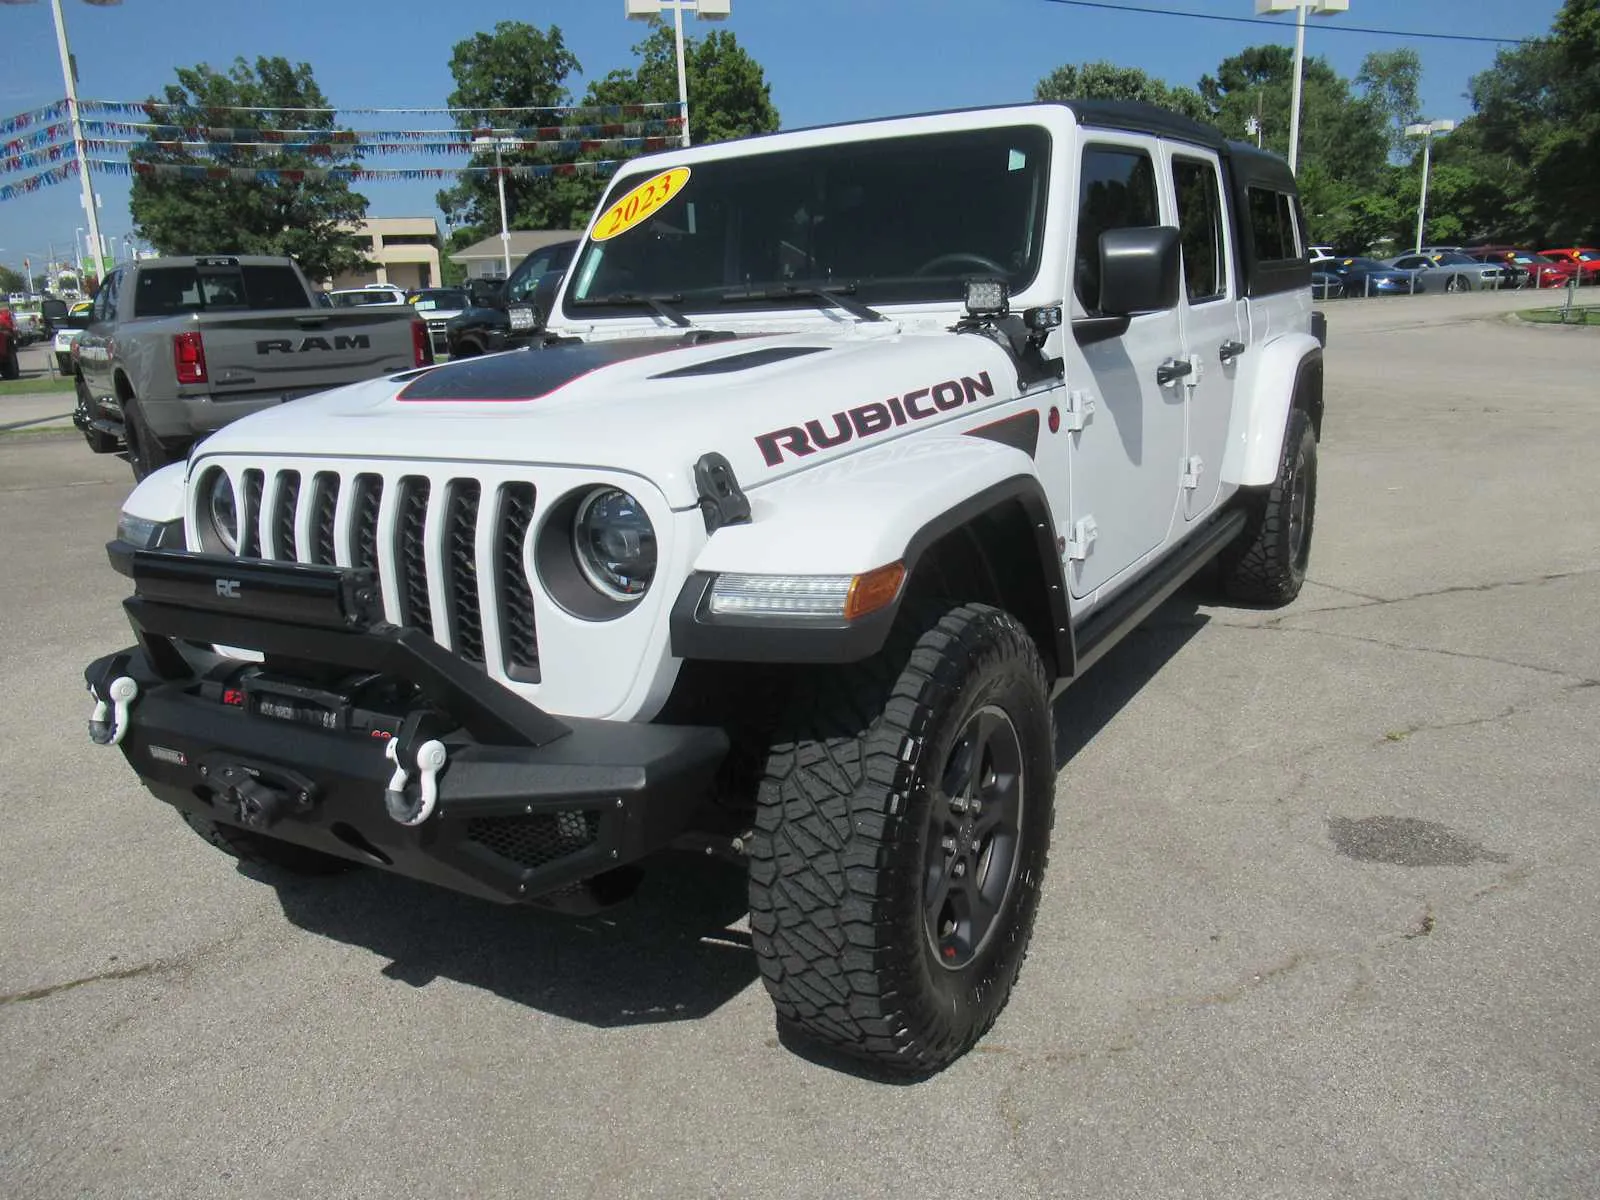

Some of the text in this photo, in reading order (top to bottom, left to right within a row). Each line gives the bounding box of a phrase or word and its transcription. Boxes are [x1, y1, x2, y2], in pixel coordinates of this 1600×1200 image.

[607, 174, 672, 235] 2023
[256, 334, 371, 355] RAM
[754, 370, 995, 468] RUBICON
[215, 579, 241, 598] RC
